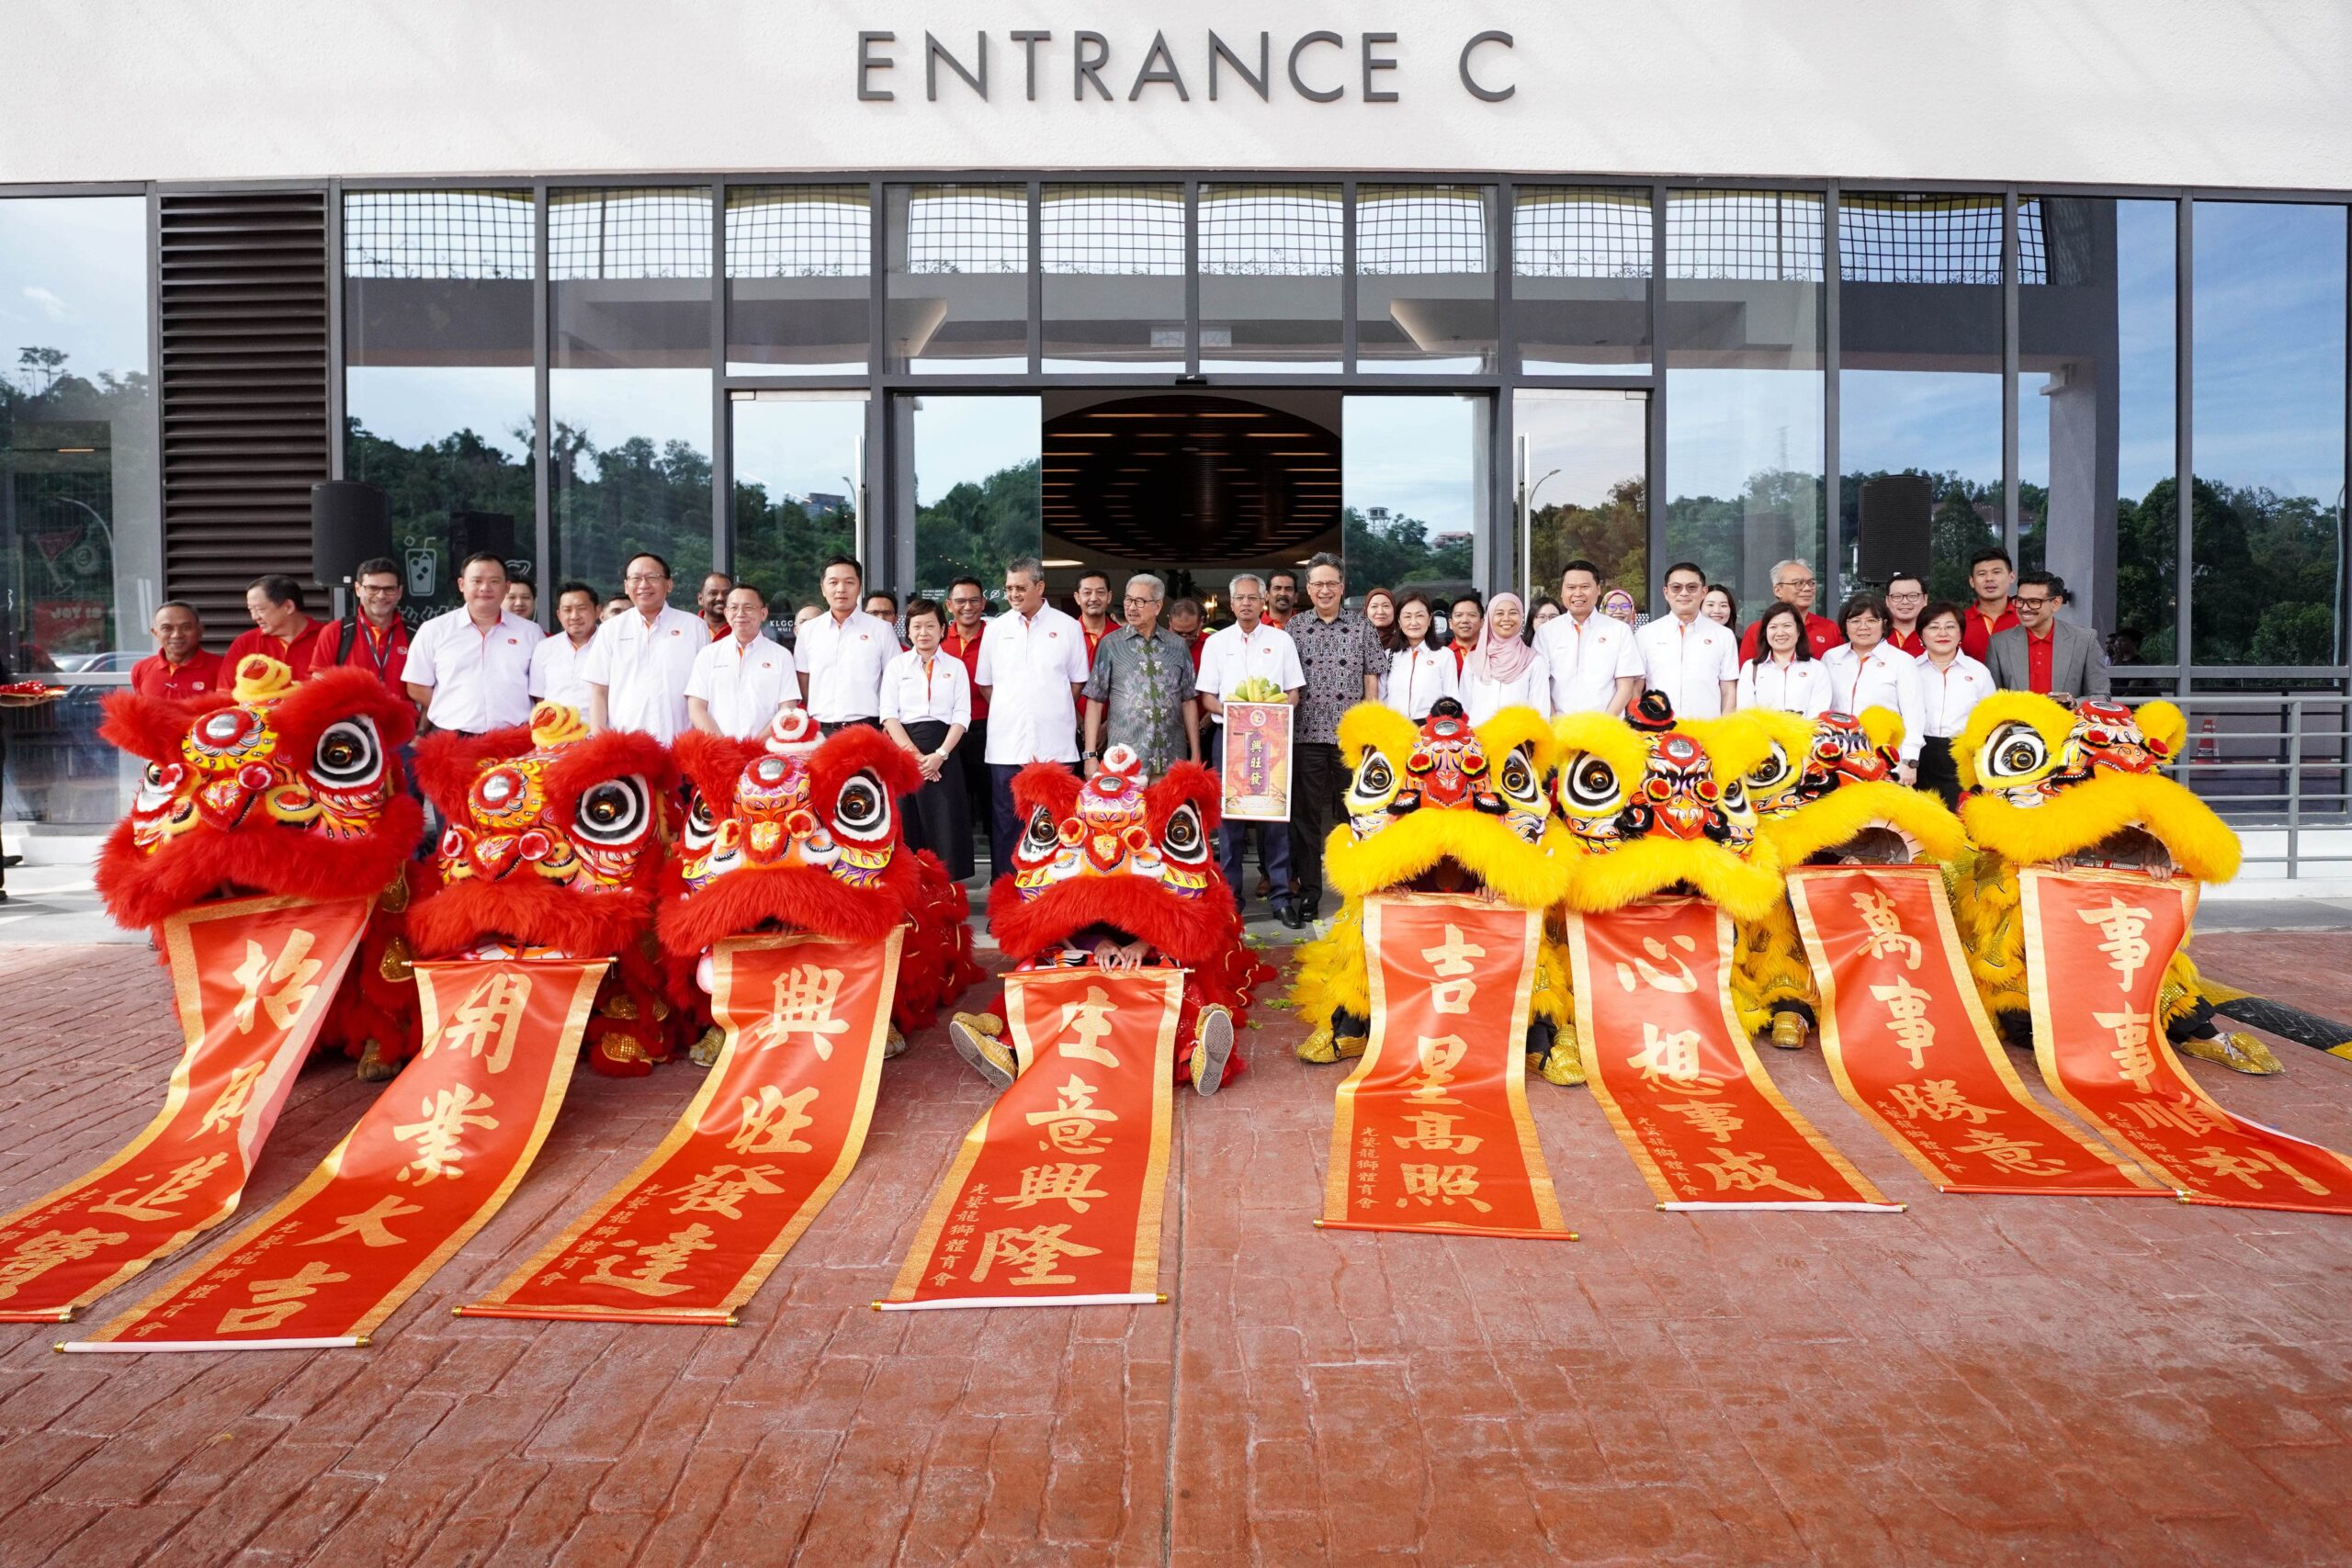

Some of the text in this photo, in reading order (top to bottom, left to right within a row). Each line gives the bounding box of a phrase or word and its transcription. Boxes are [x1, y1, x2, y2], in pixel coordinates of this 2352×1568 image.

[856, 28, 1516, 104] ENTRANCE C
[216, 973, 533, 1335] 開業大吉
[580, 964, 851, 1297] 興旺發達
[969, 986, 1120, 1286] 生意興隆
[1615, 934, 1825, 1201] 心想事成
[1849, 887, 2073, 1176] 萬事勝意
[2076, 897, 2331, 1196] 事事順利
